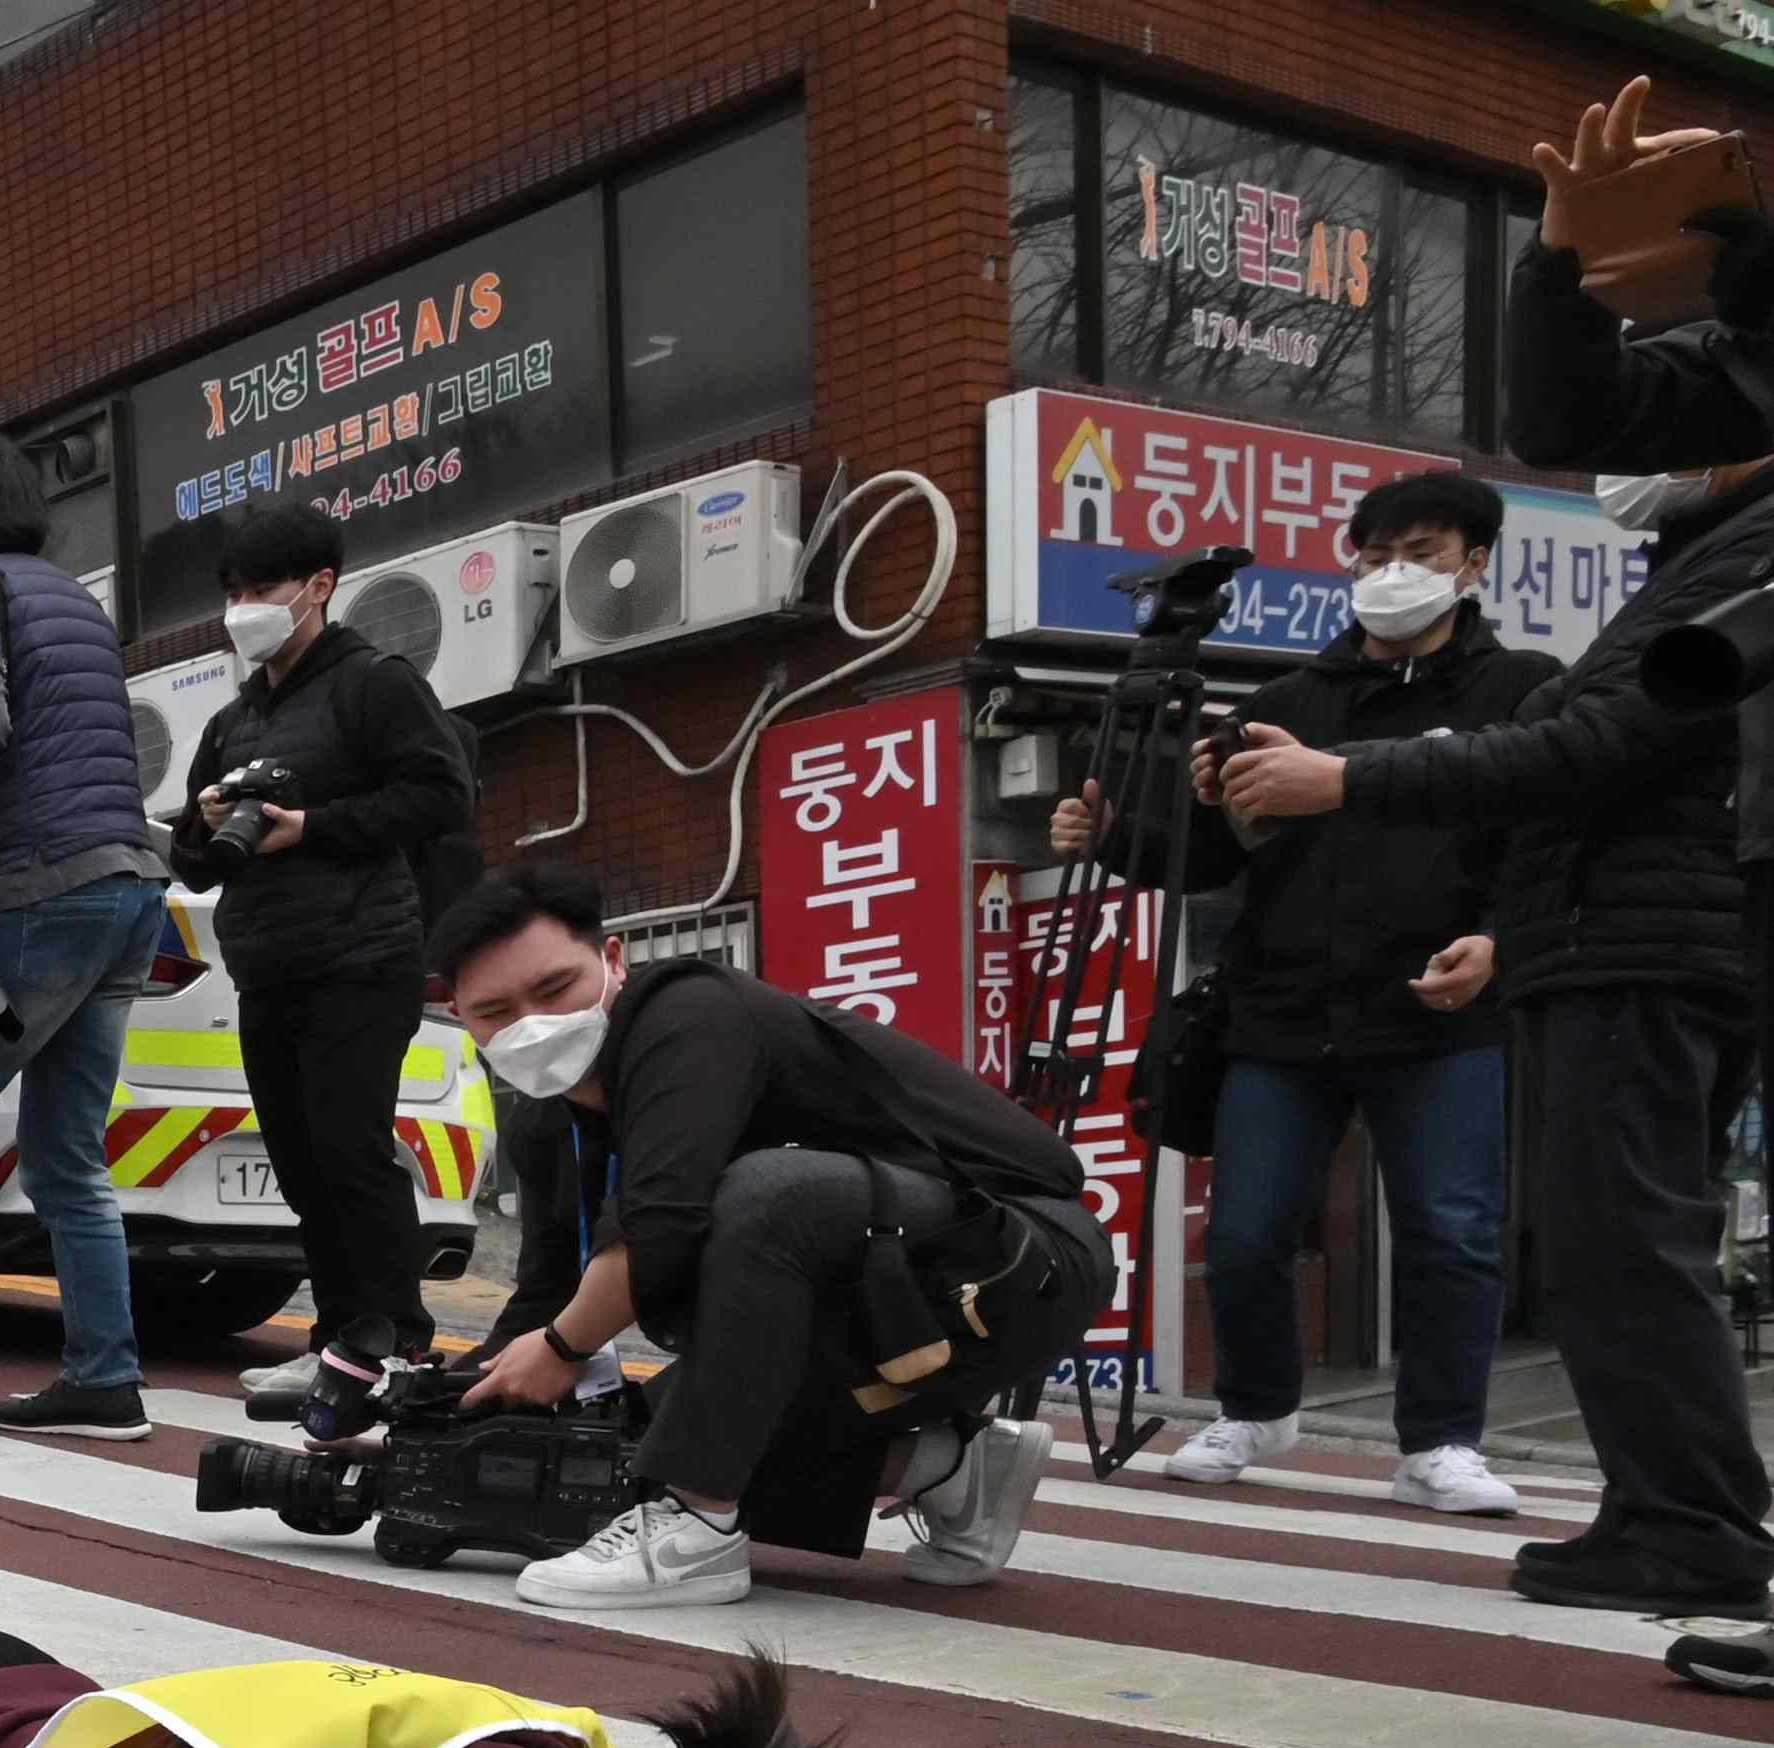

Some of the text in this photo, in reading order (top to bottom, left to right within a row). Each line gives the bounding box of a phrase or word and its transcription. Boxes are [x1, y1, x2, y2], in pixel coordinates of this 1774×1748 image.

[1162, 175, 1370, 307] 거성 골프 A/S
[230, 272, 502, 426] 거성 골프 A/S
[1134, 432, 1378, 569] 둥지부동
[464, 598, 493, 624] LG
[172, 665, 226, 691] SAMSUNG
[779, 718, 938, 832] 둥지
